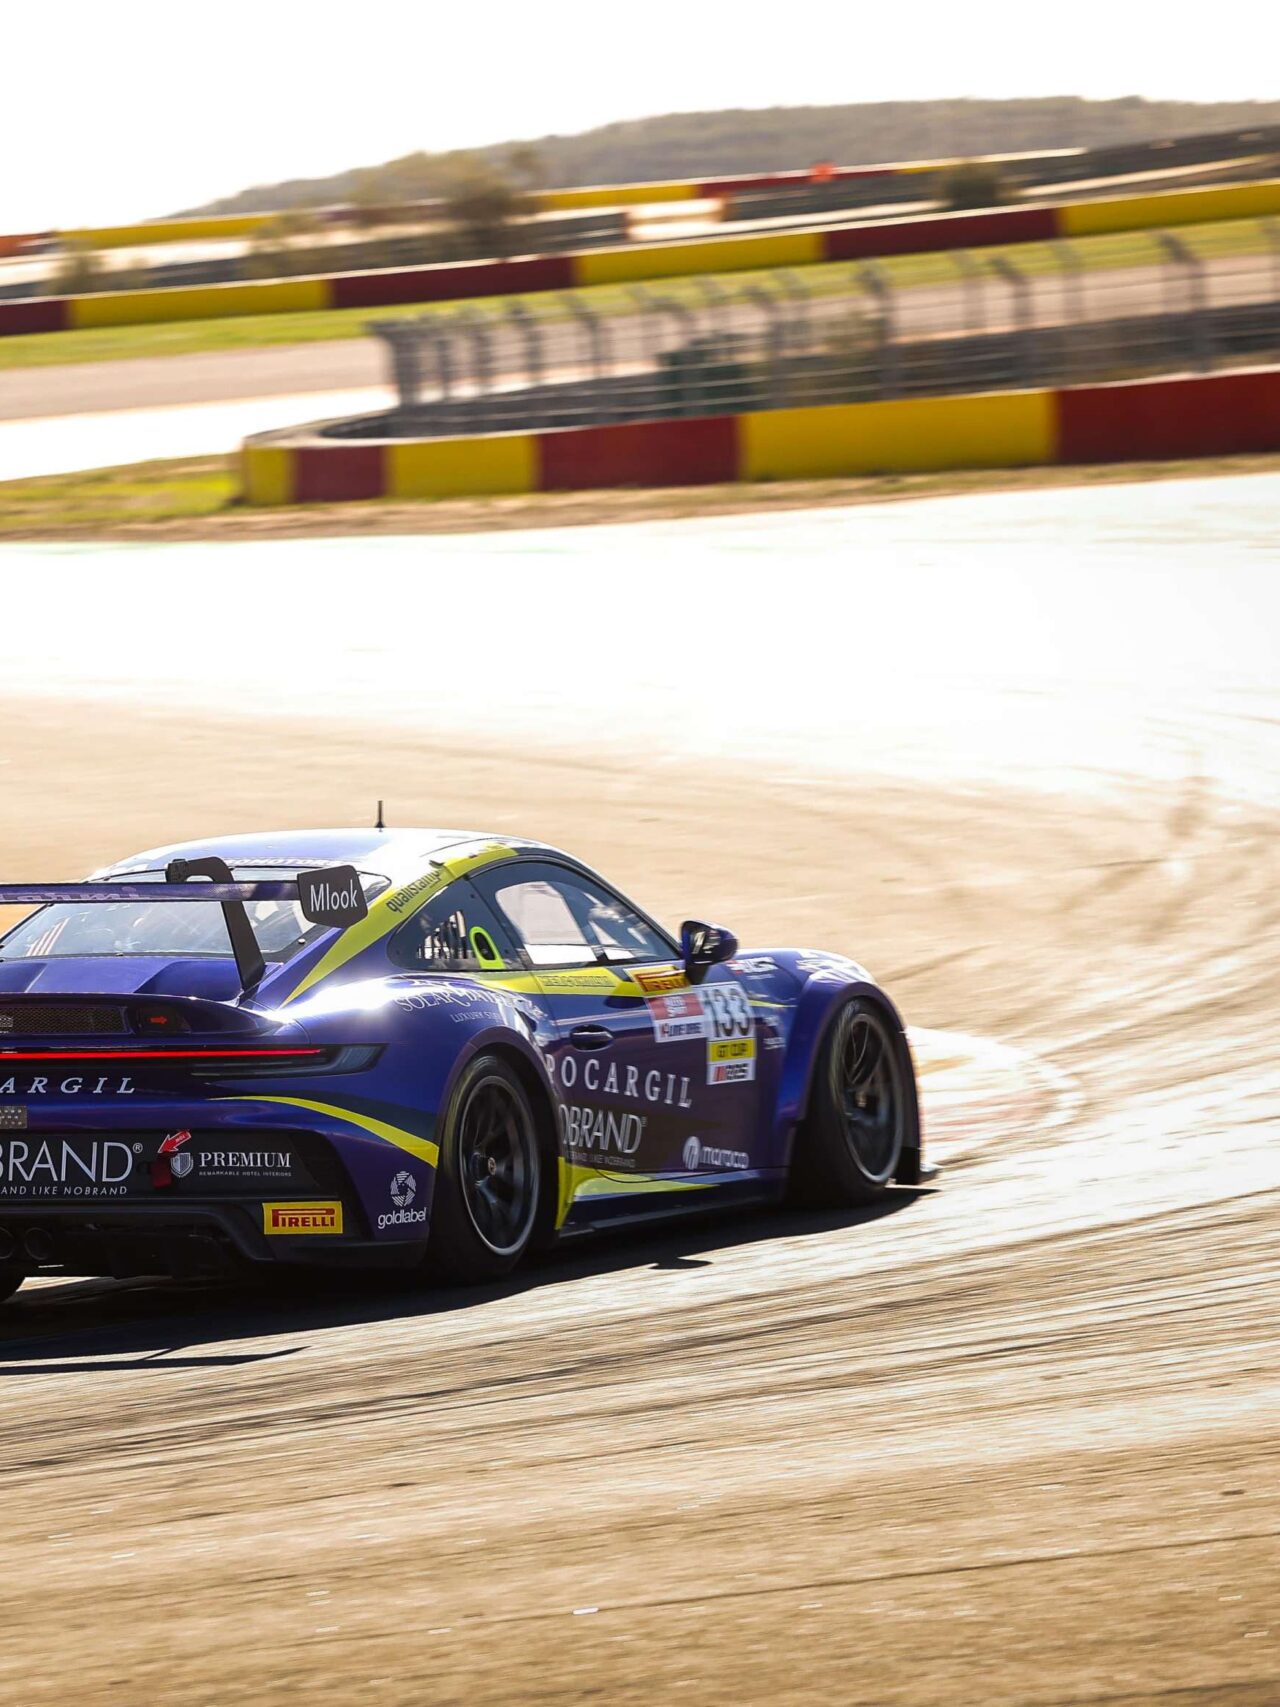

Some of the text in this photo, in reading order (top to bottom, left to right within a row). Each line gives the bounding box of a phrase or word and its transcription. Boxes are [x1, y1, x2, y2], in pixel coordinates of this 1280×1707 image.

[310, 880, 358, 912] Mlook
[395, 989, 468, 1012] SOLAR
[704, 988, 751, 1038] 133
[545, 1054, 692, 1108] POCARGIL
[199, 1151, 291, 1168] PREMIUM
[32, 1186, 58, 1195] LIKE
[63, 1186, 127, 1195] NOBRAND
[272, 1208, 335, 1228] PIRELLI
[378, 1207, 427, 1229] goldlabel
